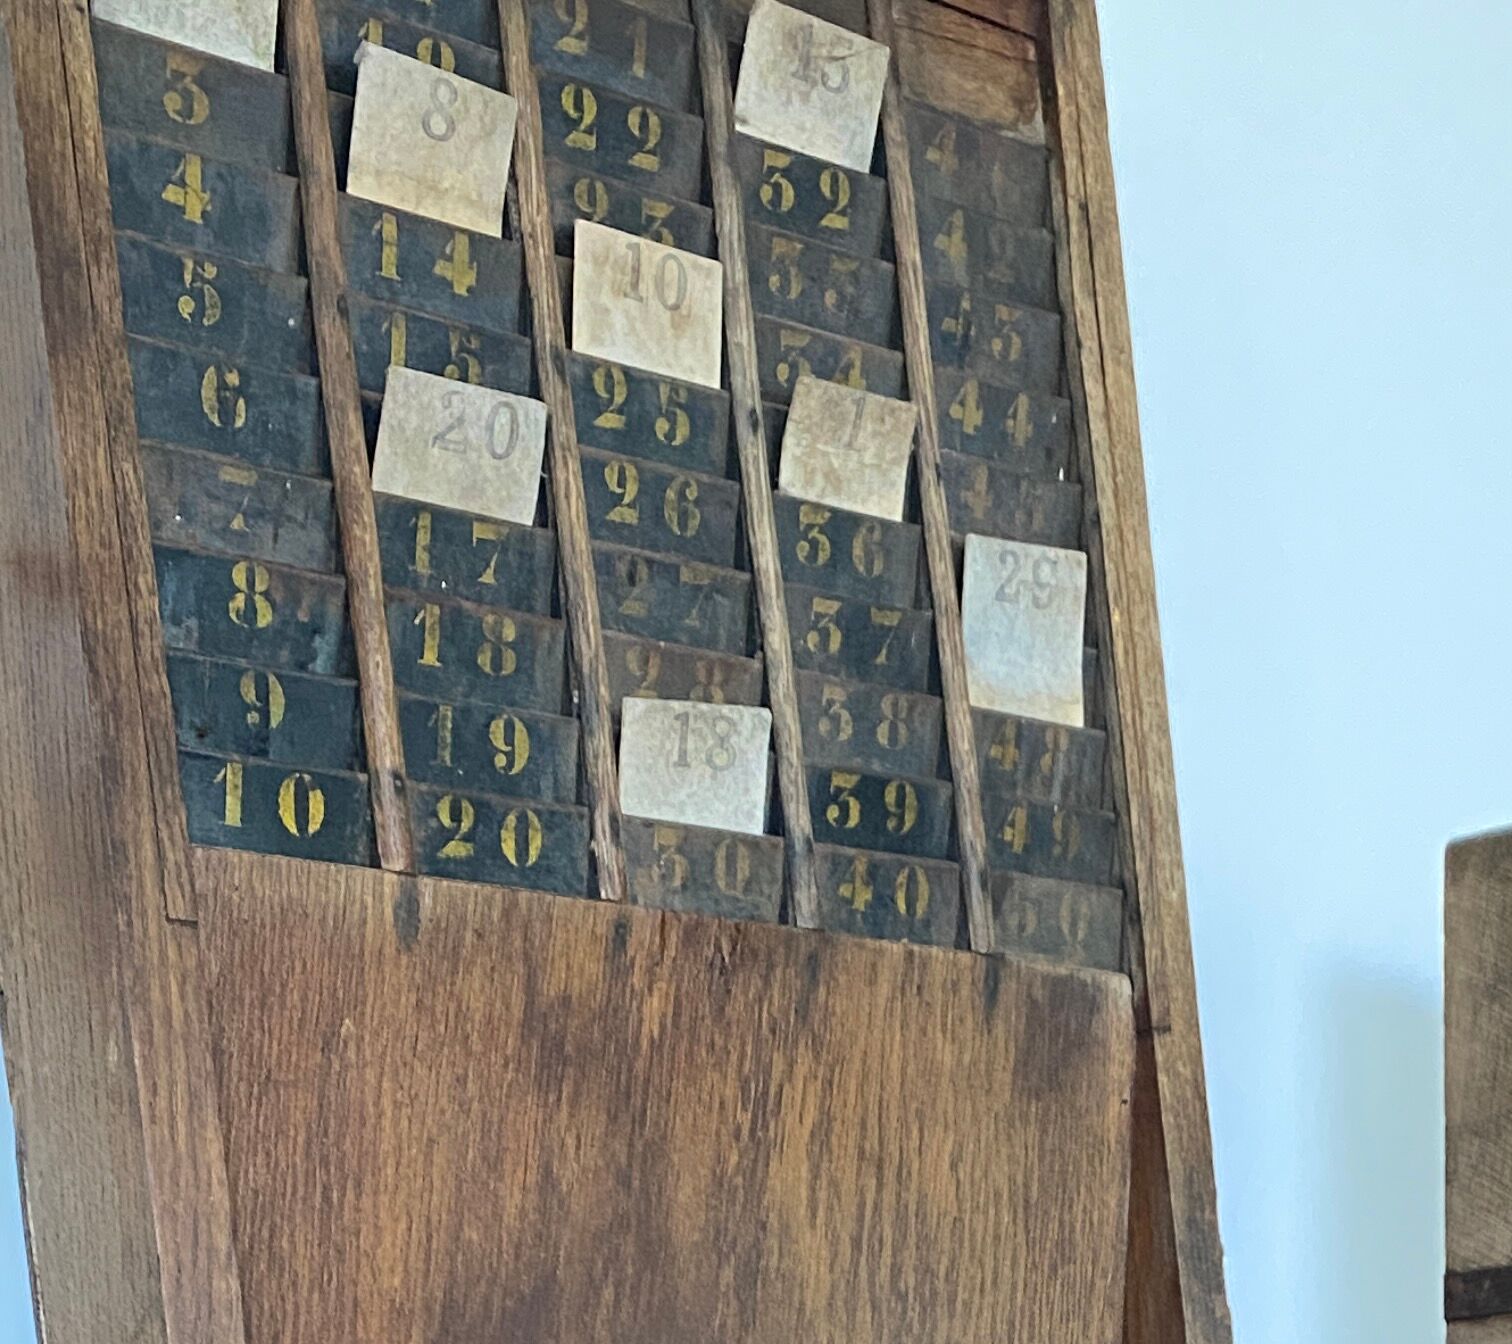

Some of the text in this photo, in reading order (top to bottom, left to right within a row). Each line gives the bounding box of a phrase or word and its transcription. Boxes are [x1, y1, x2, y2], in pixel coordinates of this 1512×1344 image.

[422, 77, 458, 142] 8
[561, 83, 662, 172] 22
[161, 153, 212, 224] 4
[371, 212, 477, 297] 14
[623, 241, 689, 311] 10
[177, 256, 222, 327] 5
[201, 364, 247, 430] 6
[429, 389, 521, 461] 20
[592, 364, 691, 446] 25
[949, 376, 1034, 449] 44
[604, 459, 701, 538] 26
[408, 511, 509, 585] 17
[228, 560, 273, 629] 8
[414, 603, 517, 676] 18
[240, 669, 286, 730] 9
[427, 703, 530, 776] 19
[672, 709, 738, 771] 18
[213, 761, 325, 838] 10
[436, 794, 543, 868] 20
[838, 855, 930, 920] 40
